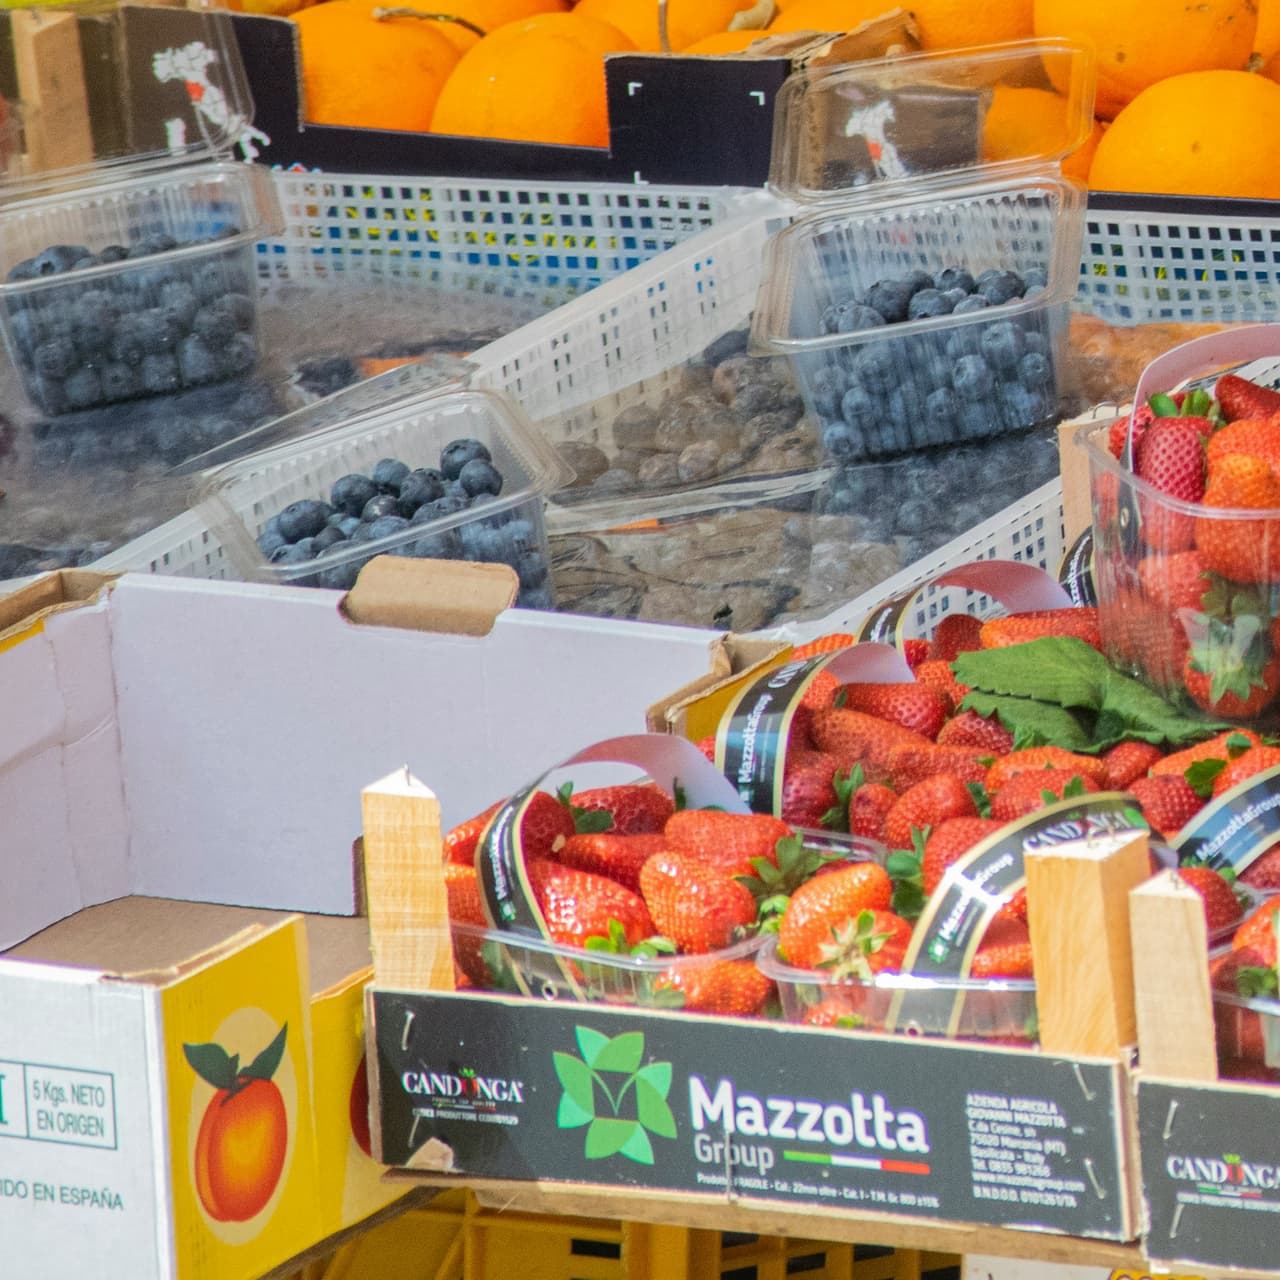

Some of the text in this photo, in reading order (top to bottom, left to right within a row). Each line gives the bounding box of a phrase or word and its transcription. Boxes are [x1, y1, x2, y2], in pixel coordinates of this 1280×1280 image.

[737, 693, 774, 786] MazzottaGroup
[32, 1079, 41, 1101] 5
[42, 1079, 69, 1109] Kgs.
[71, 1083, 106, 1109] NETO
[401, 1070, 525, 1104] CANDONGA
[36, 1109, 105, 1138] EN ORIGEN
[688, 1074, 931, 1154] Mazzotta
[693, 1133, 775, 1176] Group
[32, 1182, 55, 1203] EN
[58, 1184, 124, 1211] ESPAÑA
